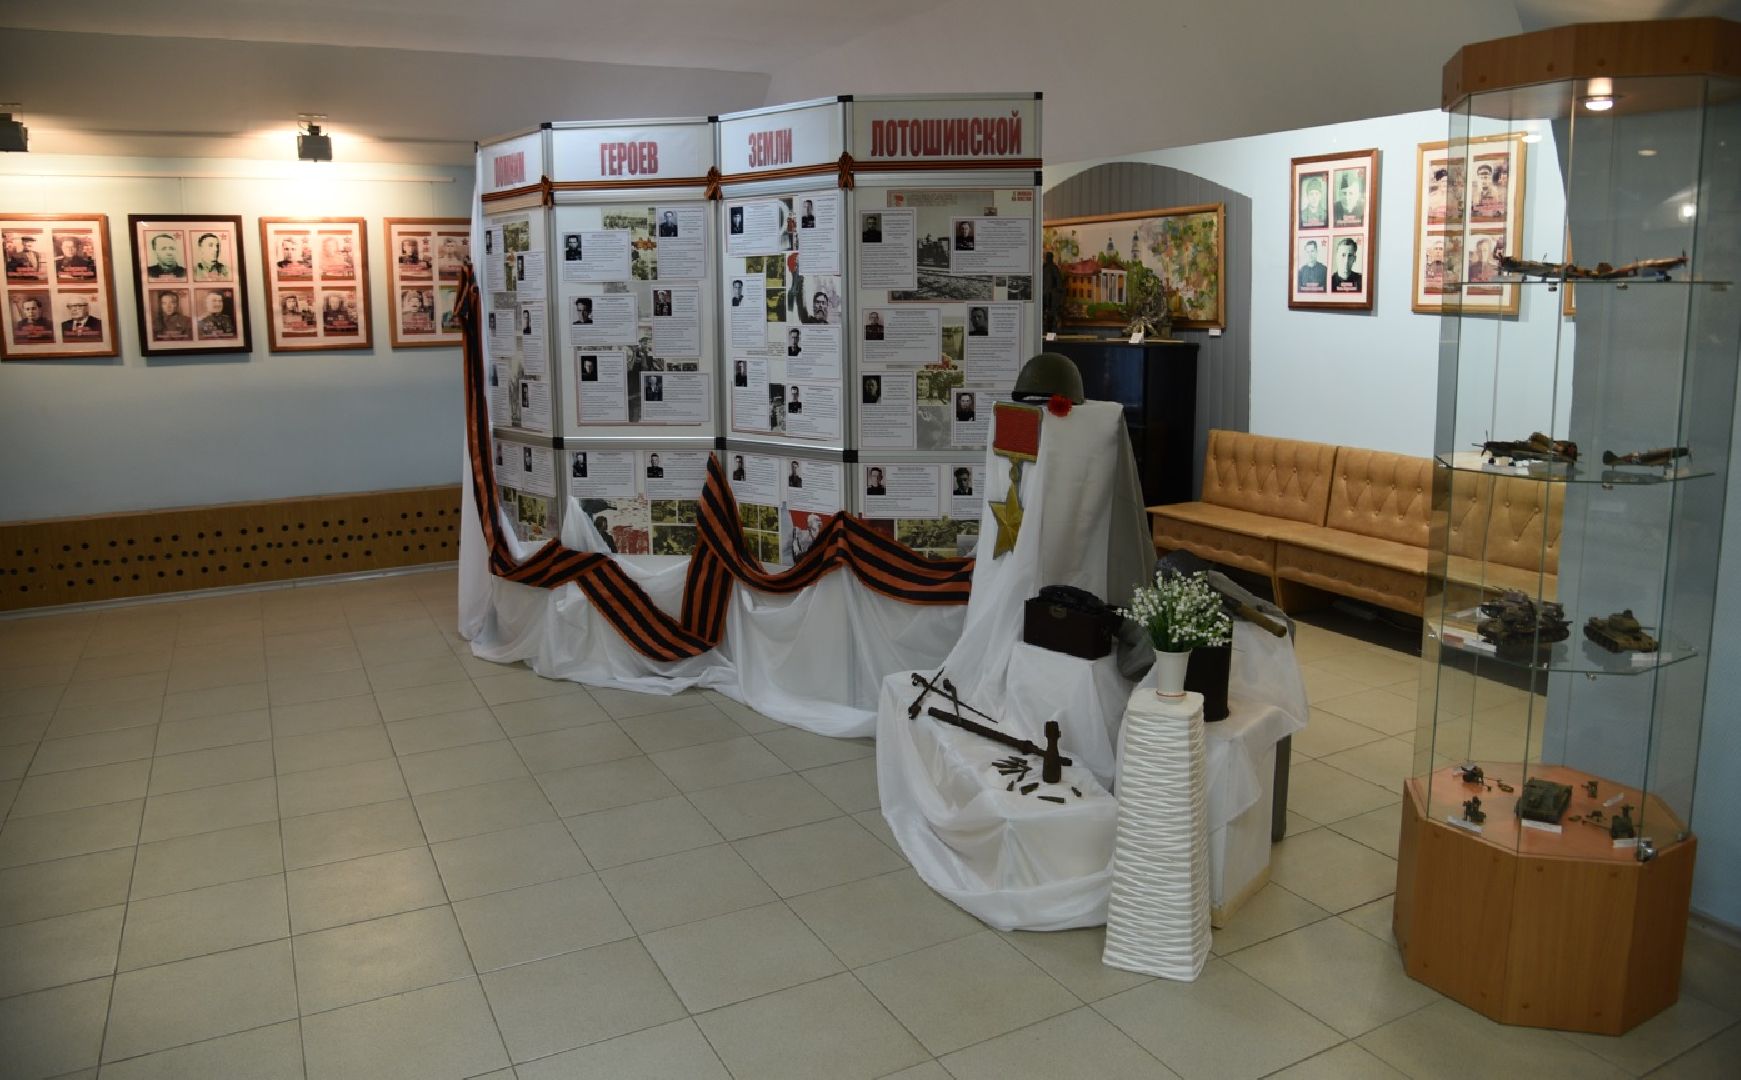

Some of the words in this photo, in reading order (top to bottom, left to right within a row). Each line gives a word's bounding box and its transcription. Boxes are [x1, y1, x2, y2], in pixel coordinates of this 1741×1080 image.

[748, 127, 793, 168] ЗЕМЛИ
[871, 110, 1022, 157] ЛОТОШИНСКОЙ
[600, 141, 659, 176] ГЕРОЕВ
